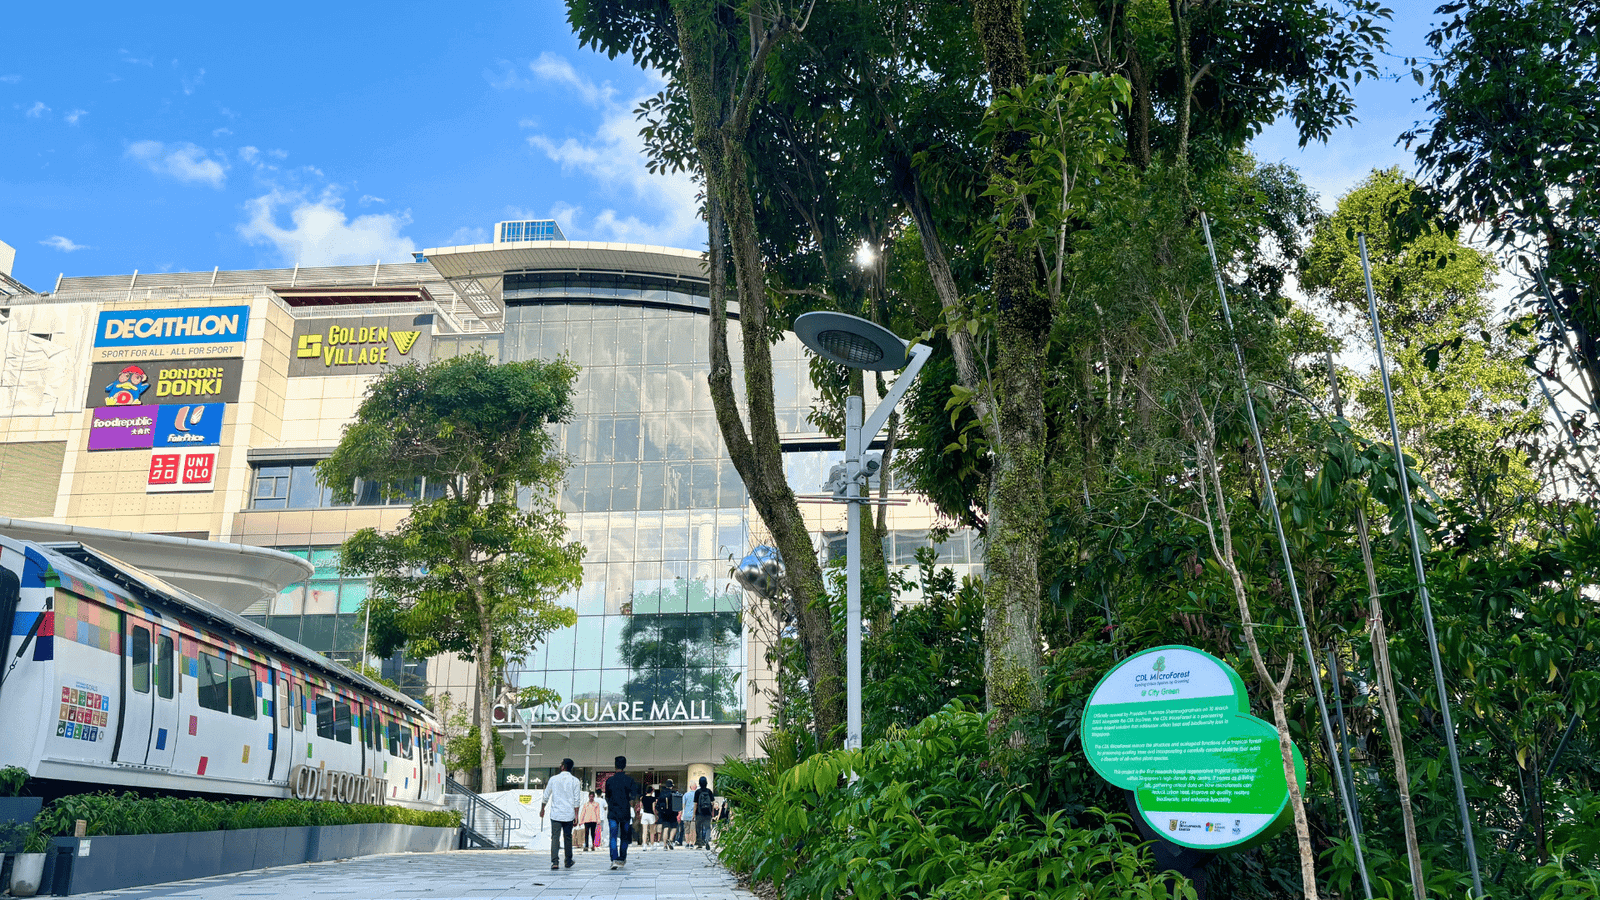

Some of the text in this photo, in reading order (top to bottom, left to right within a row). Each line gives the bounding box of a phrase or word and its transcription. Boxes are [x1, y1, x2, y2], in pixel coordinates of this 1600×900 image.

[105, 314, 239, 340] DECATHLON
[102, 350, 129, 359] SPORT
[131, 349, 148, 357] FOR
[150, 348, 165, 356] ALL
[171, 347, 187, 356] ALL
[189, 346, 206, 355] FOR
[207, 346, 234, 354] SPORT
[156, 378, 222, 397] DONKI
[187, 456, 208, 467] UNI
[186, 468, 208, 480] QLO
[1135, 674, 1147, 682] CDL
[493, 700, 710, 723] CIY SQUARE MALL
[295, 765, 325, 800] CDL
